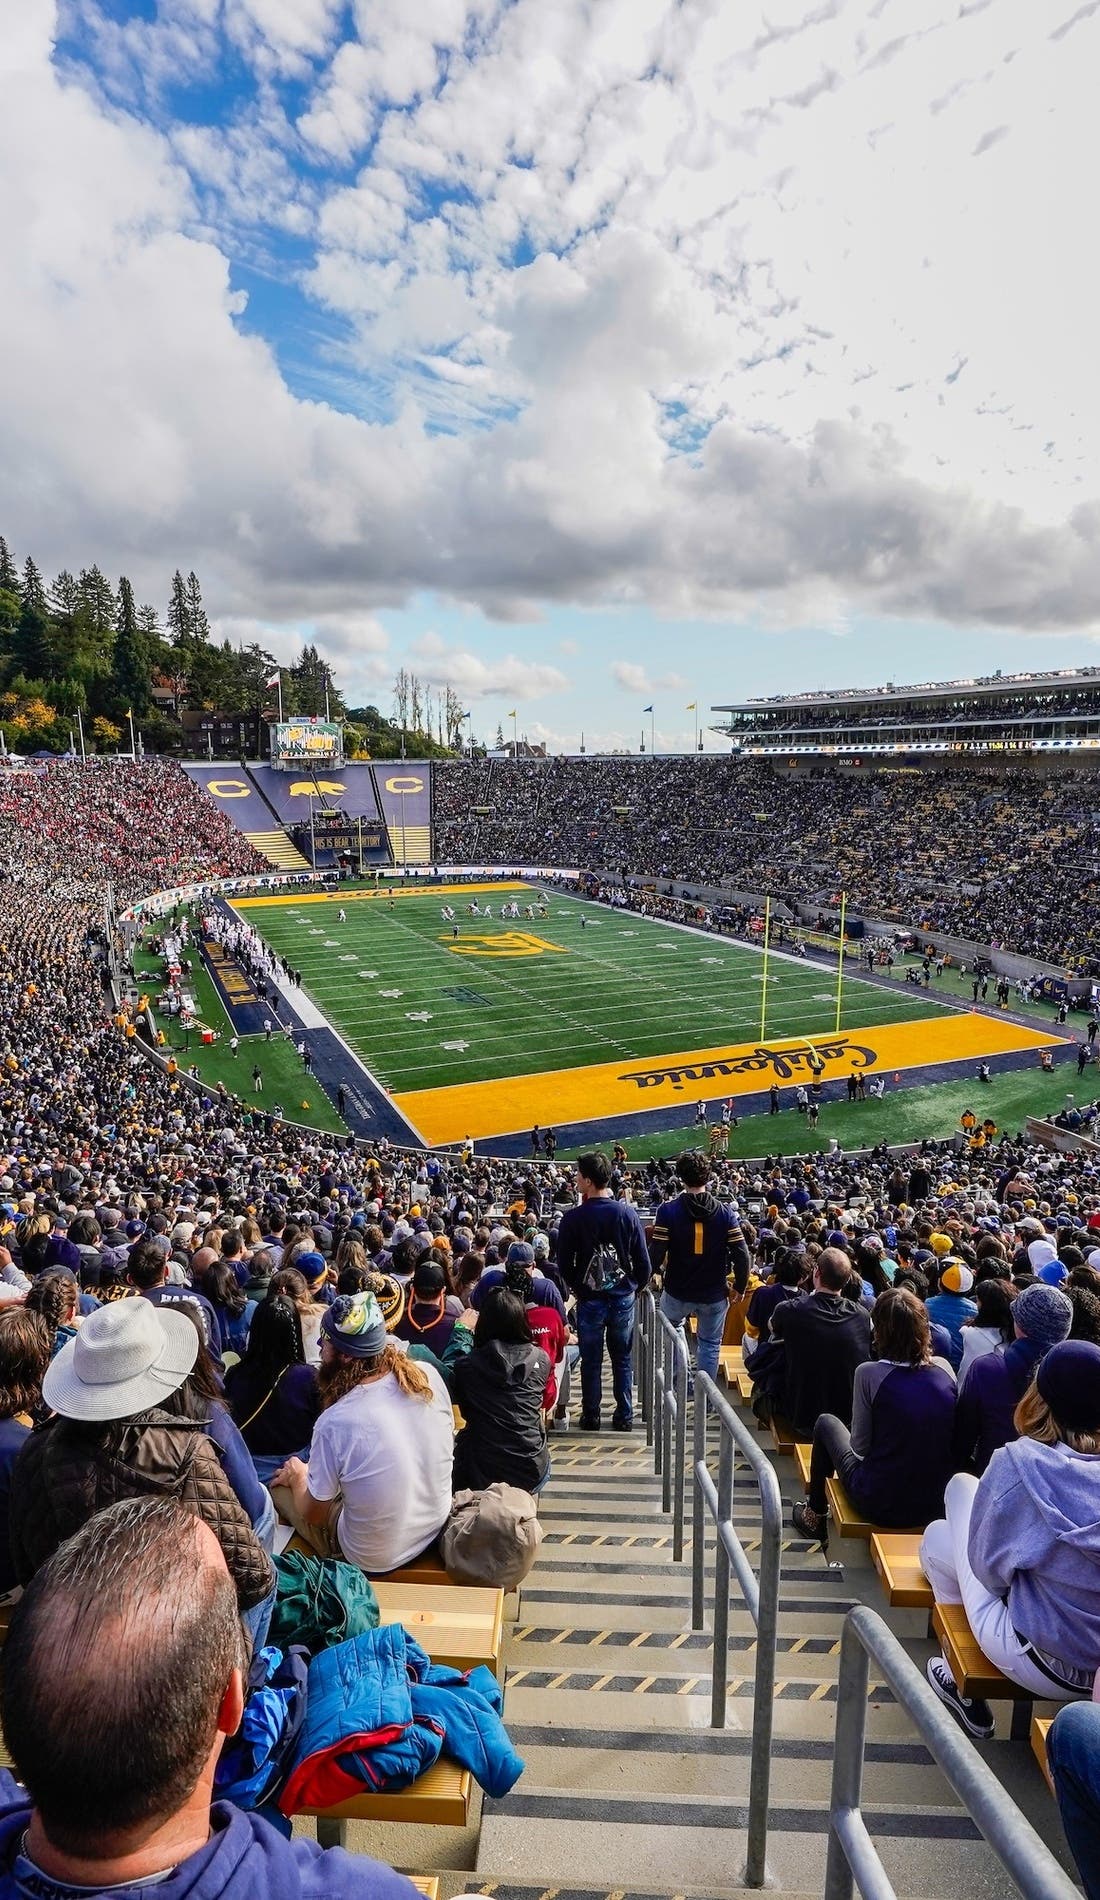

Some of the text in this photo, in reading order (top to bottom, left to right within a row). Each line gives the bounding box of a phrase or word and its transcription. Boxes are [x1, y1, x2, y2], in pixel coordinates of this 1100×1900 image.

[206, 779, 251, 798] C
[385, 776, 424, 794] C
[617, 1038, 878, 1091] California
[694, 1221, 704, 1255] 1
